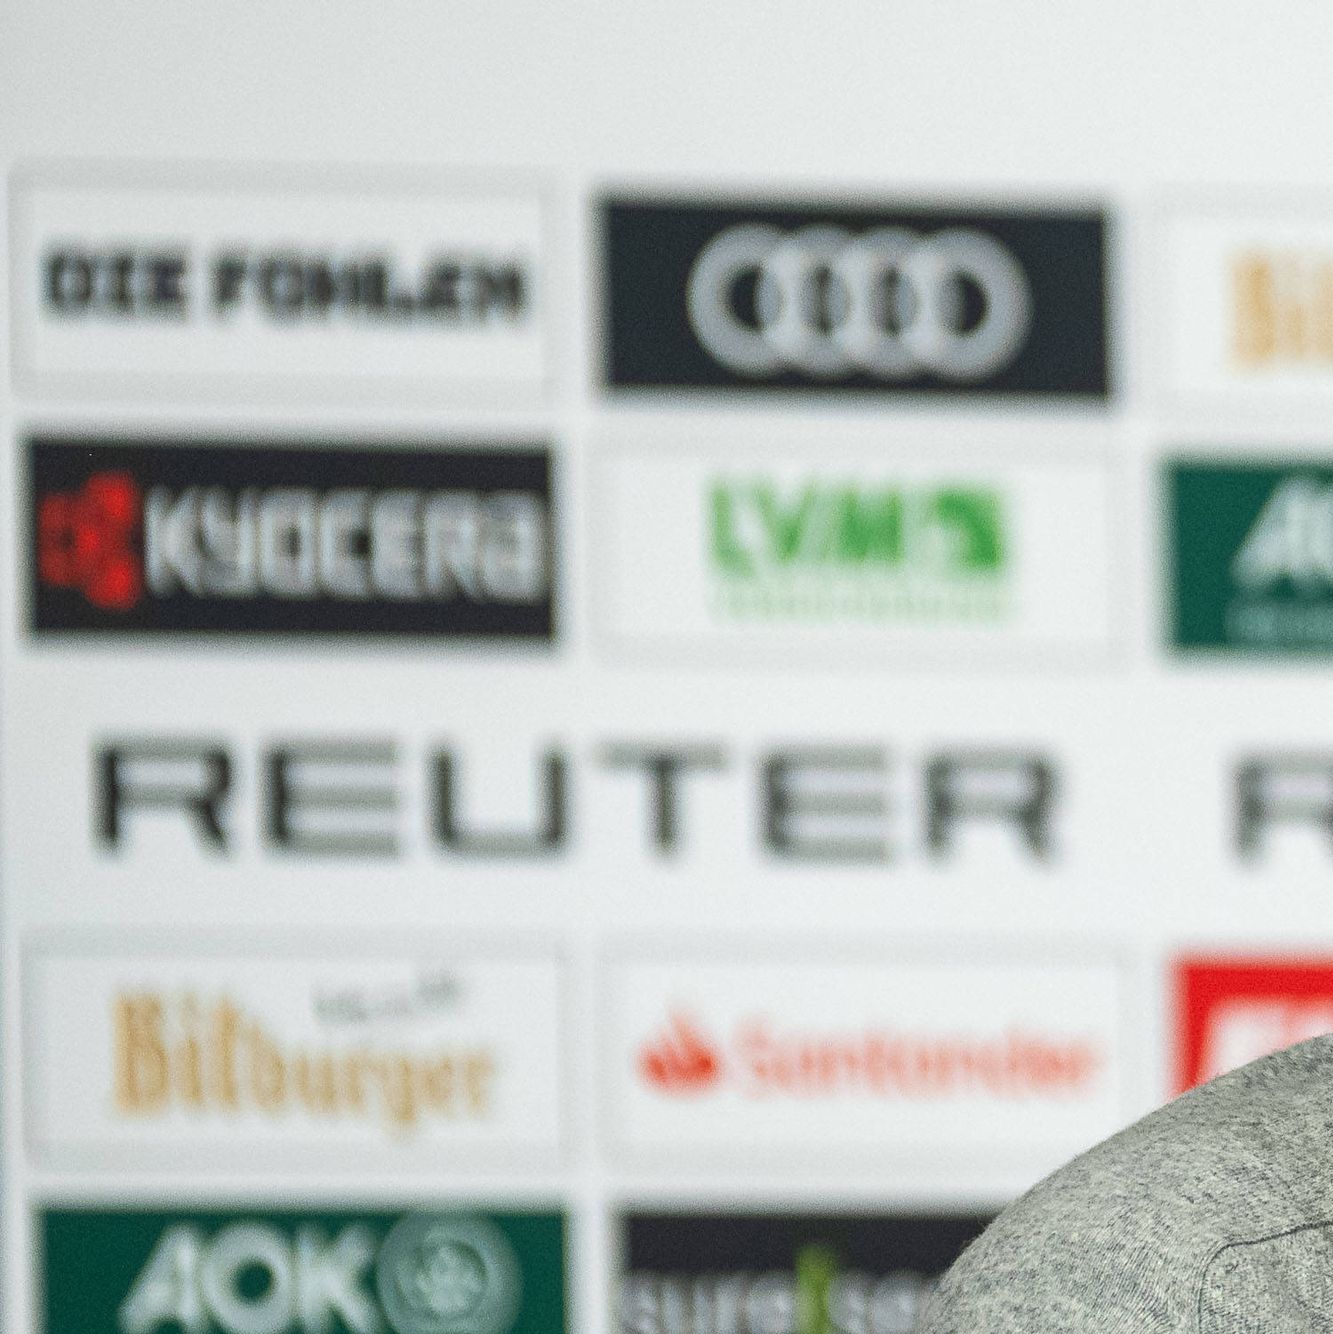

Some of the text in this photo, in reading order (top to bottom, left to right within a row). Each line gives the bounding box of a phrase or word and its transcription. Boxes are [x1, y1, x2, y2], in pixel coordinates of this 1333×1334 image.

[143, 483, 546, 602] KYOCERA
[93, 733, 1062, 864] REUTER
[114, 983, 496, 1138] Bitburger
